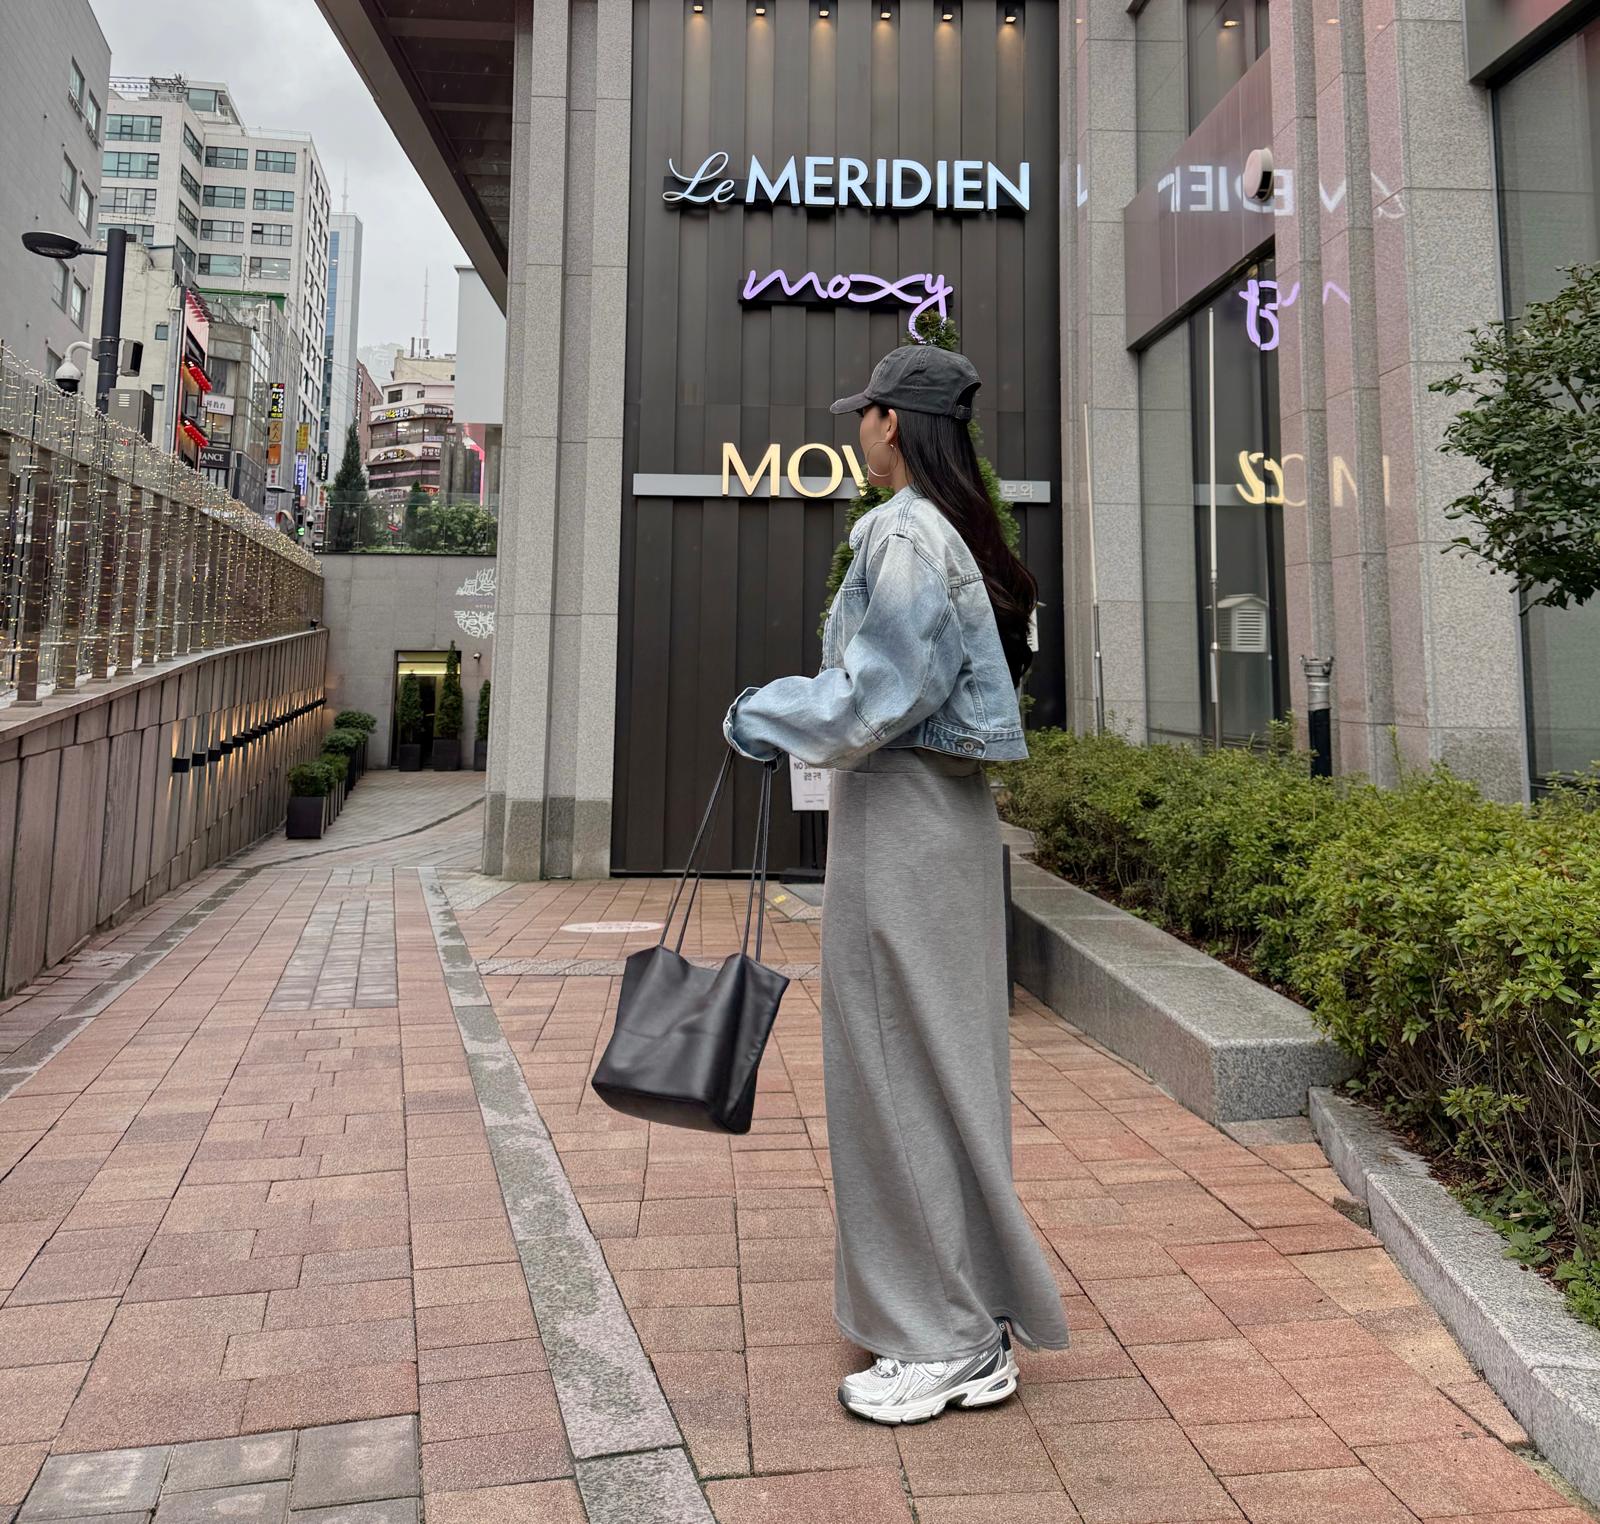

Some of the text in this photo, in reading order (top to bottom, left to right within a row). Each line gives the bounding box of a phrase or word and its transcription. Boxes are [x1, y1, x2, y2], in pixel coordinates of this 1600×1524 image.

[662, 151, 1031, 213] Le MERIDIEN
[742, 268, 954, 344] moxy
